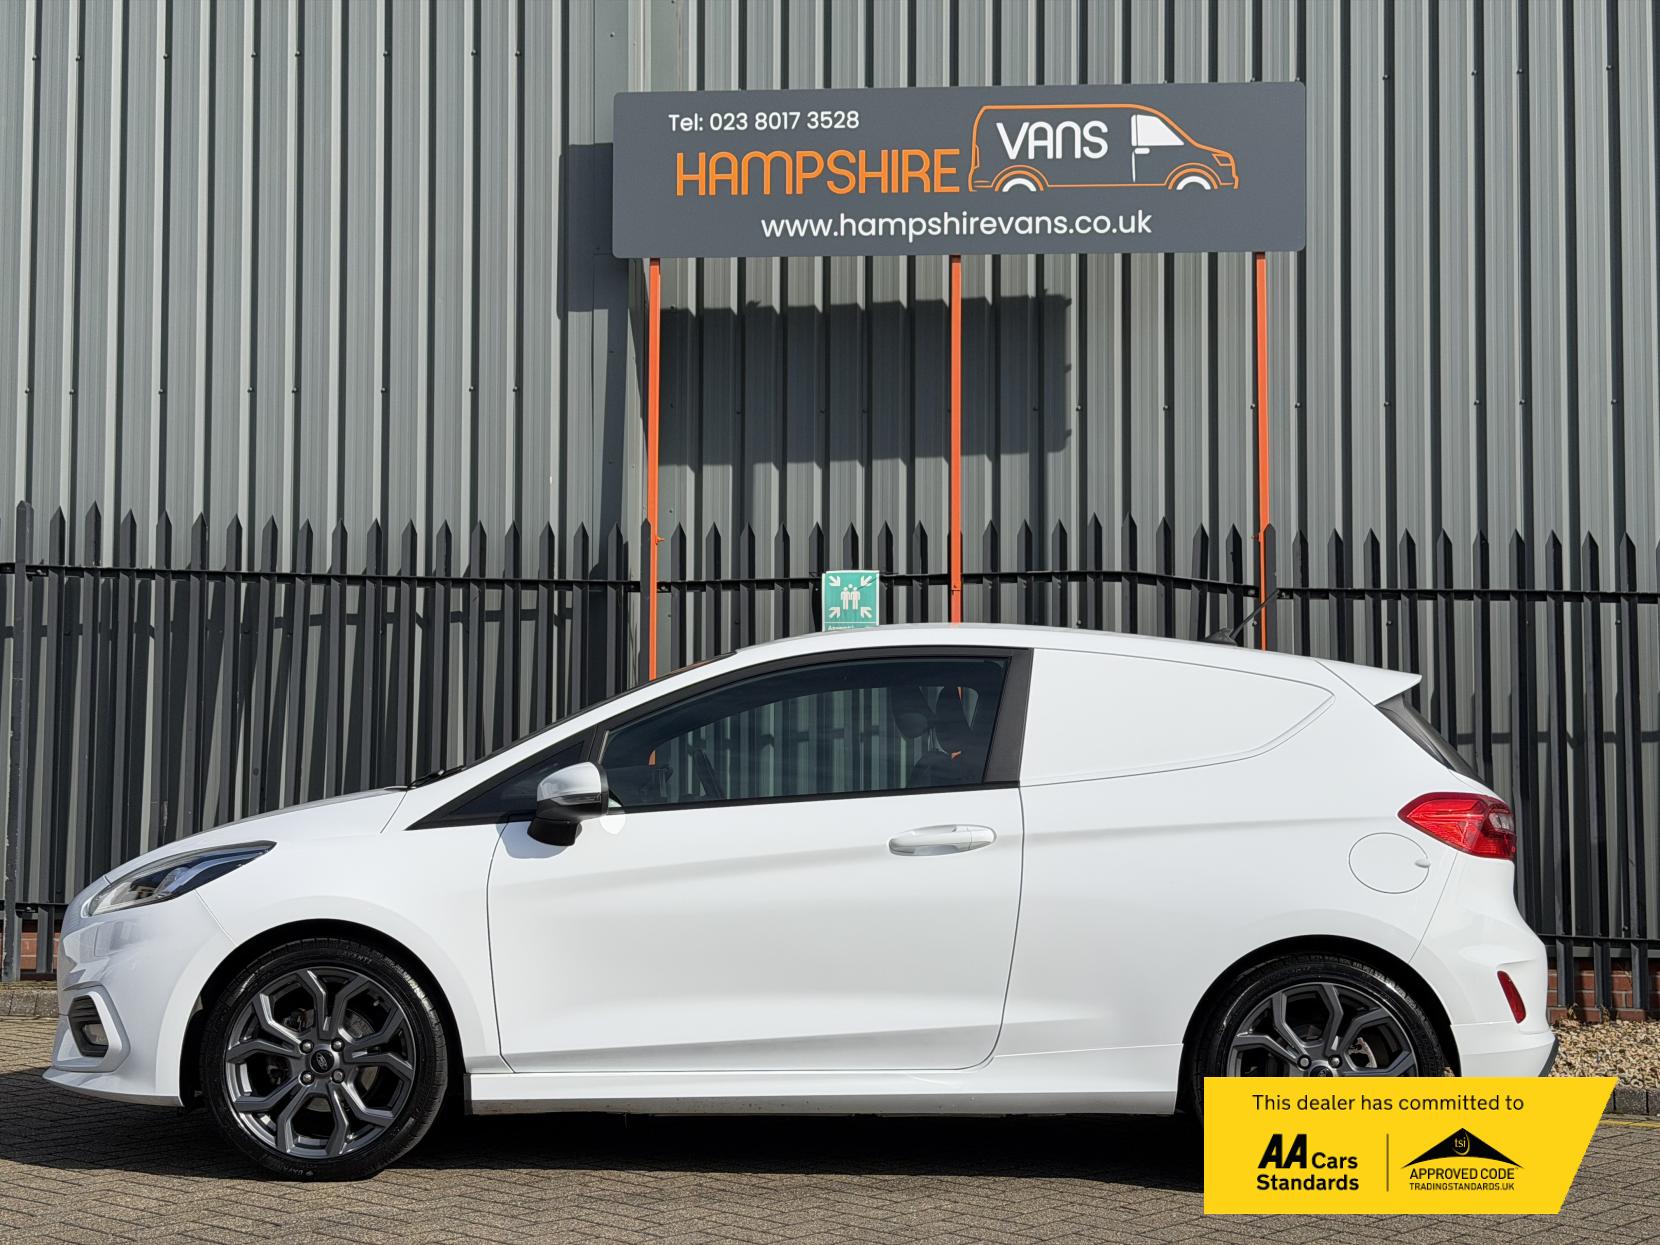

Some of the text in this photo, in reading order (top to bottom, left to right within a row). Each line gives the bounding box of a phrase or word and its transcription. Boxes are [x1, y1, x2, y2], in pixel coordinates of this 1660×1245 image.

[668, 110, 860, 132] Tel: 023 8017 3528
[995, 120, 1109, 160] VANS
[675, 148, 961, 198] HAMPSHIRE
[760, 209, 1152, 244] www.hampshirevans.co.uk
